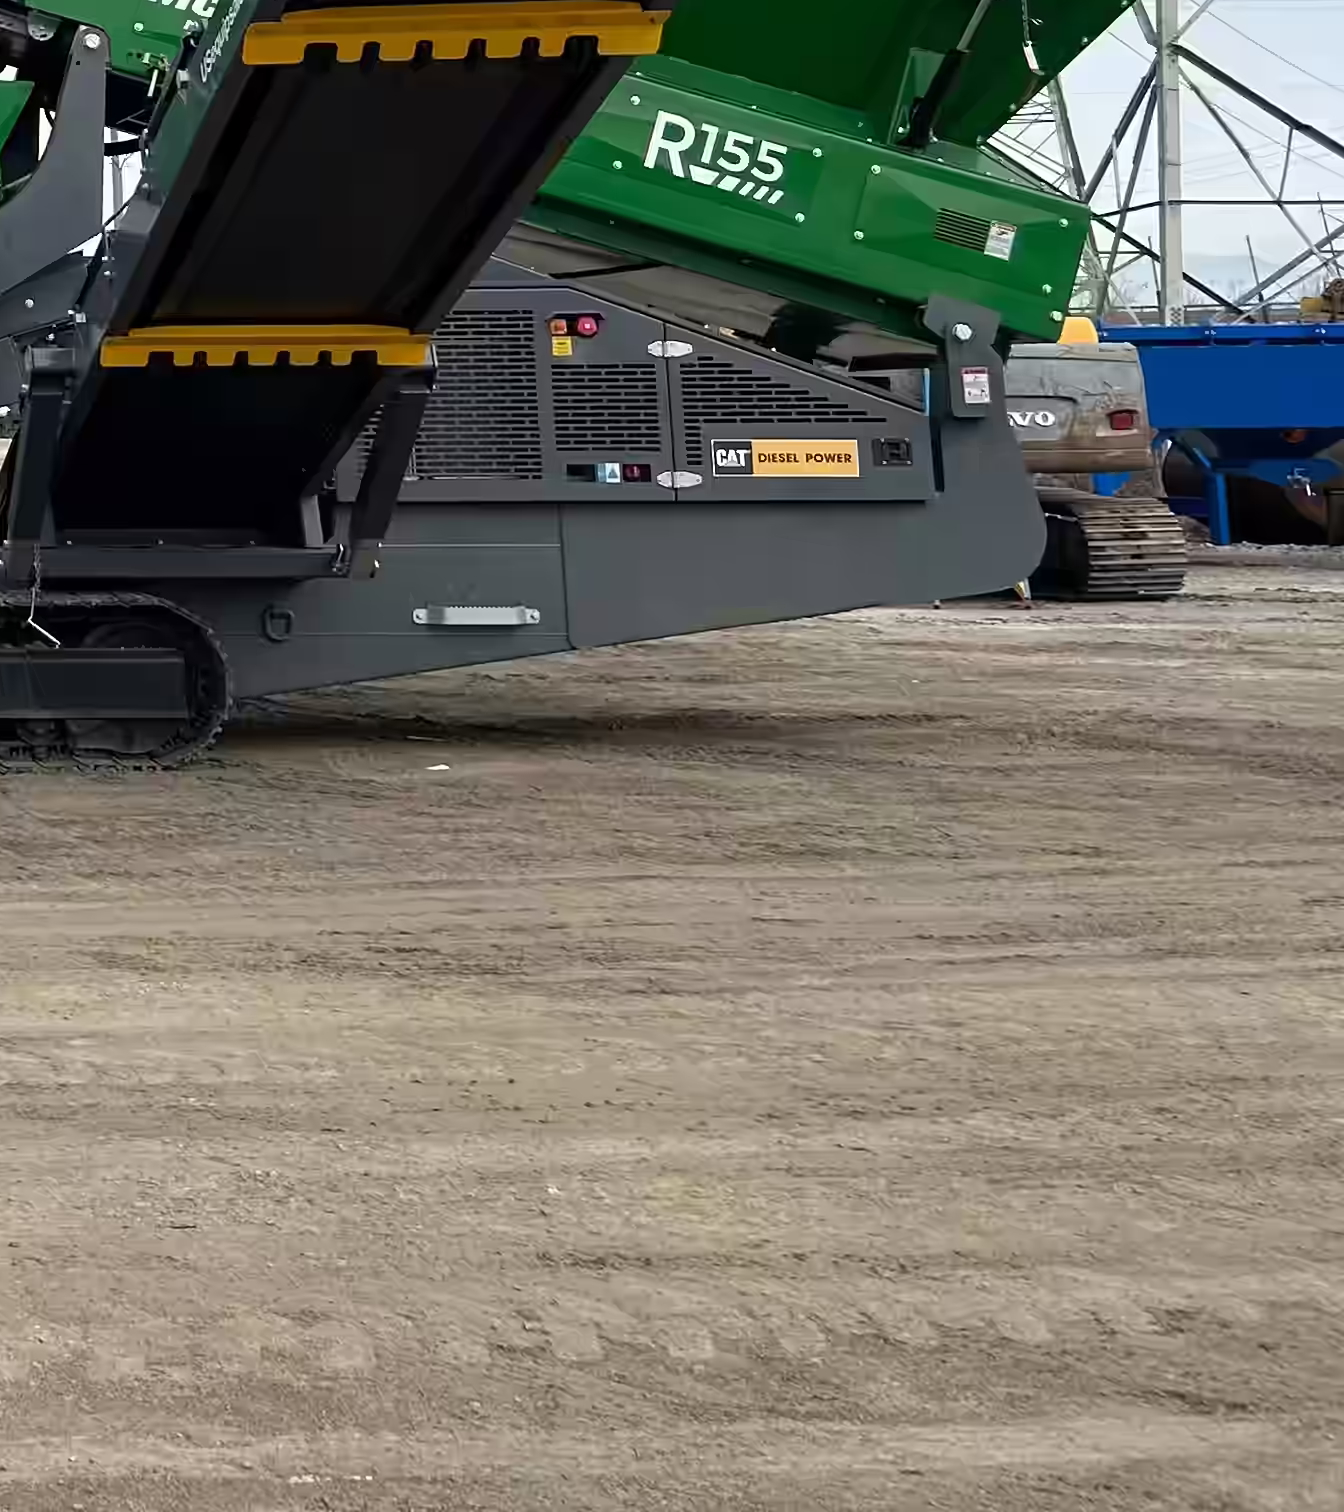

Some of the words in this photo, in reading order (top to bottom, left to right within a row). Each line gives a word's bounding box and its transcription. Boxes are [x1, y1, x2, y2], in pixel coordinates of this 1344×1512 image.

[643, 109, 788, 183] R155
[715, 448, 749, 467] CAT
[758, 452, 800, 464] DIESEL
[805, 452, 853, 464] POWER
